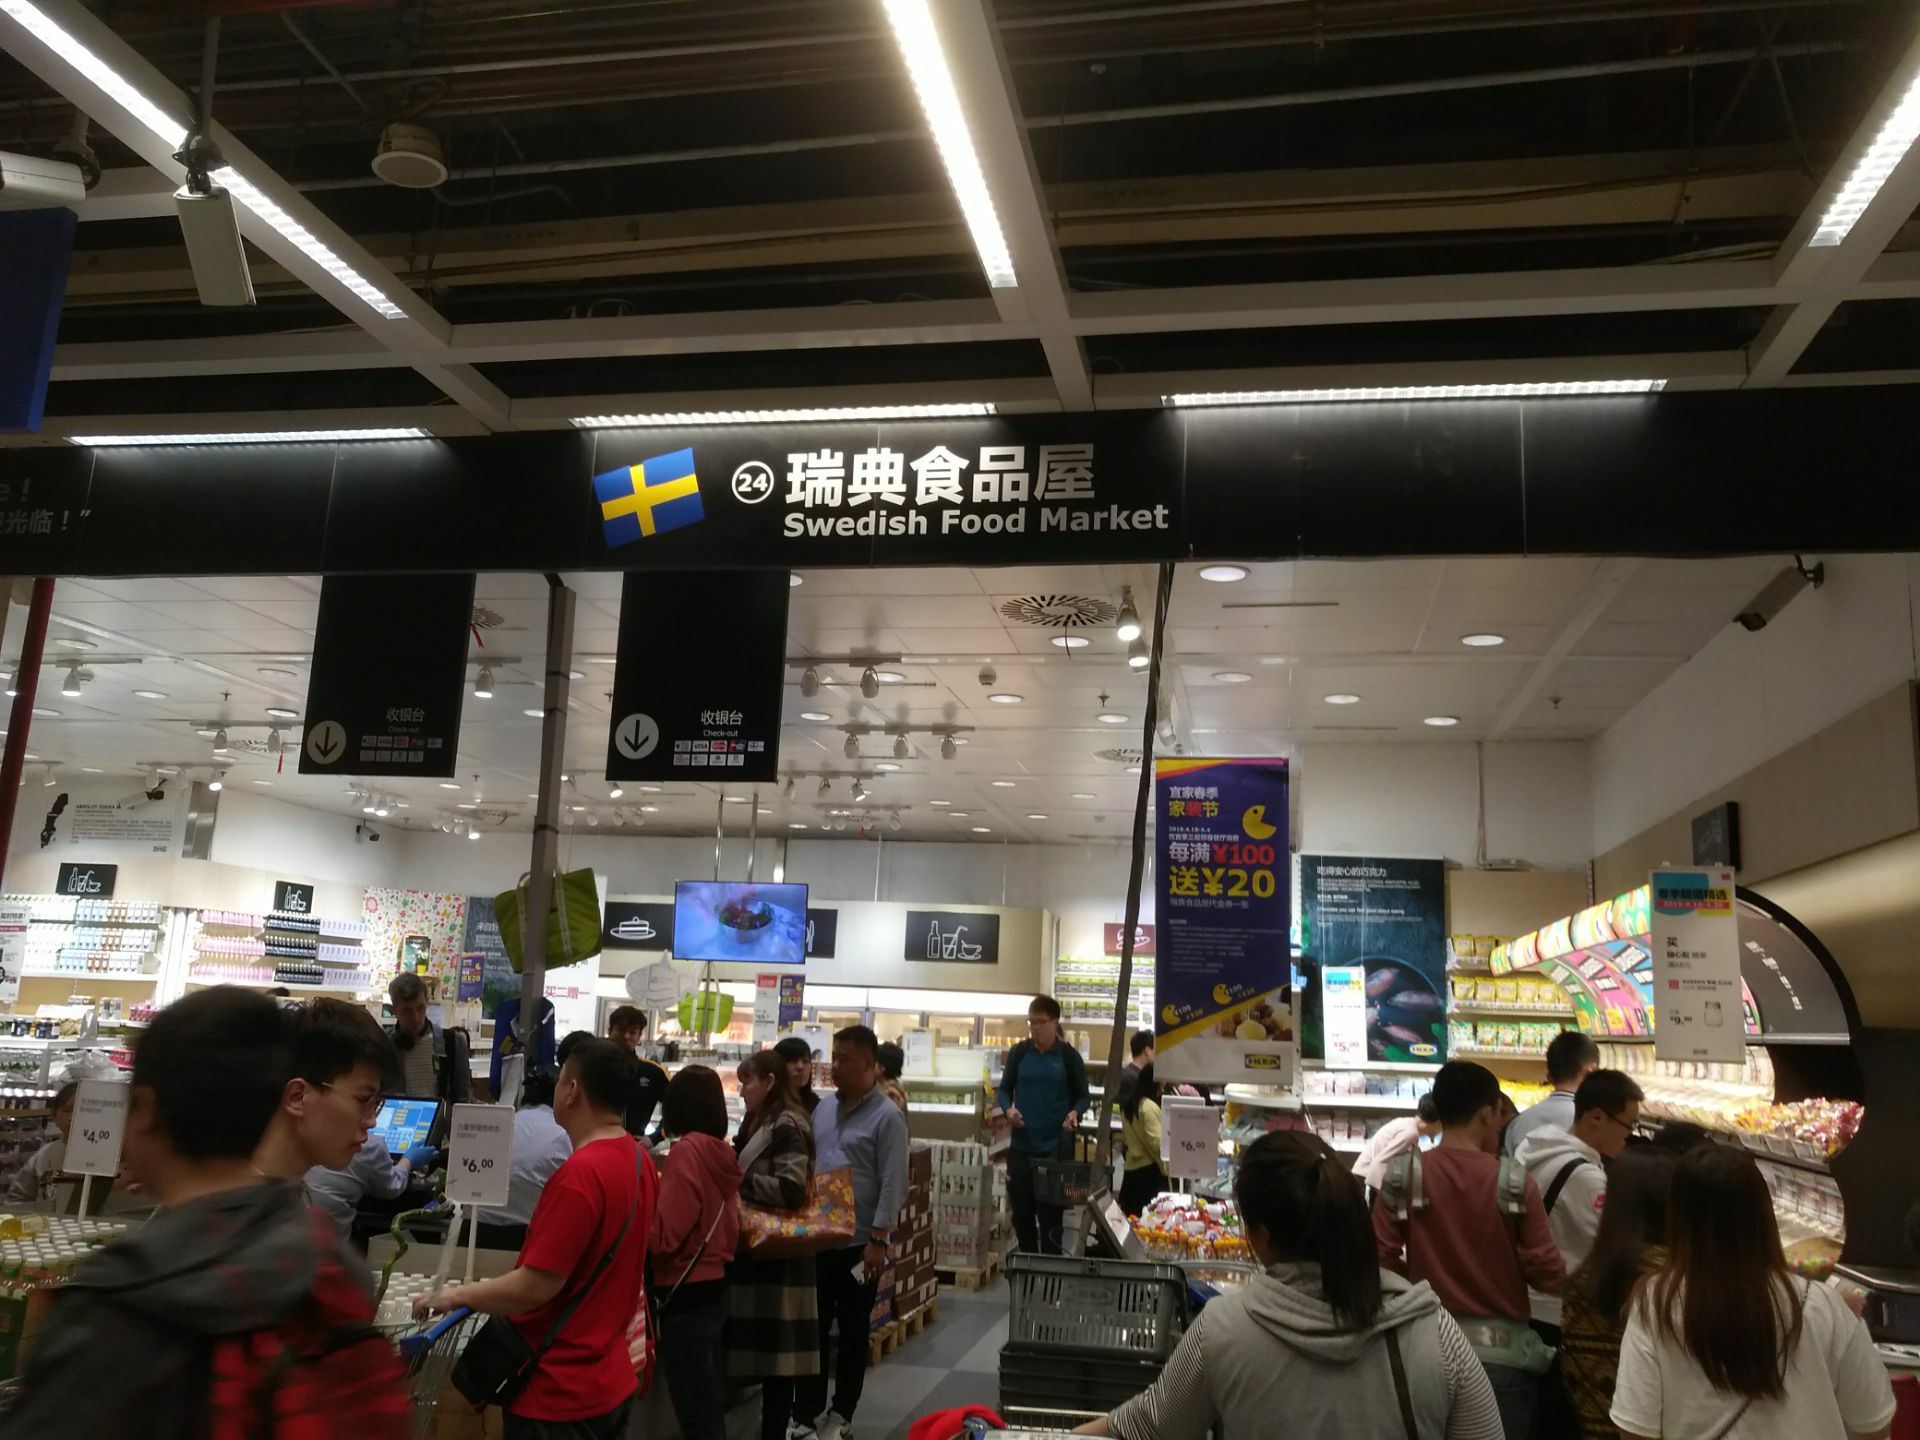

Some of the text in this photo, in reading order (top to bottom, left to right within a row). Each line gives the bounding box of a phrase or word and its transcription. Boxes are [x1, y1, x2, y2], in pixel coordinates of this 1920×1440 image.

[738, 443, 1095, 508] 24 瑞典食品屋
[783, 503, 1169, 537] Swedish Food Market
[385, 707, 425, 722] 收银台
[701, 710, 744, 726] 收银台
[703, 729, 739, 737] Check-out
[1169, 786, 1219, 800] 宜家春季
[1168, 800, 1220, 818] 家装节
[1168, 865, 1276, 899] 送¥20
[1667, 936, 1678, 948] 买
[1248, 1056, 1279, 1066] IKEA
[83, 1129, 110, 1144] ¥4.00
[1181, 1141, 1206, 1152] ¥6.00
[462, 1158, 494, 1173] ¥6.00
